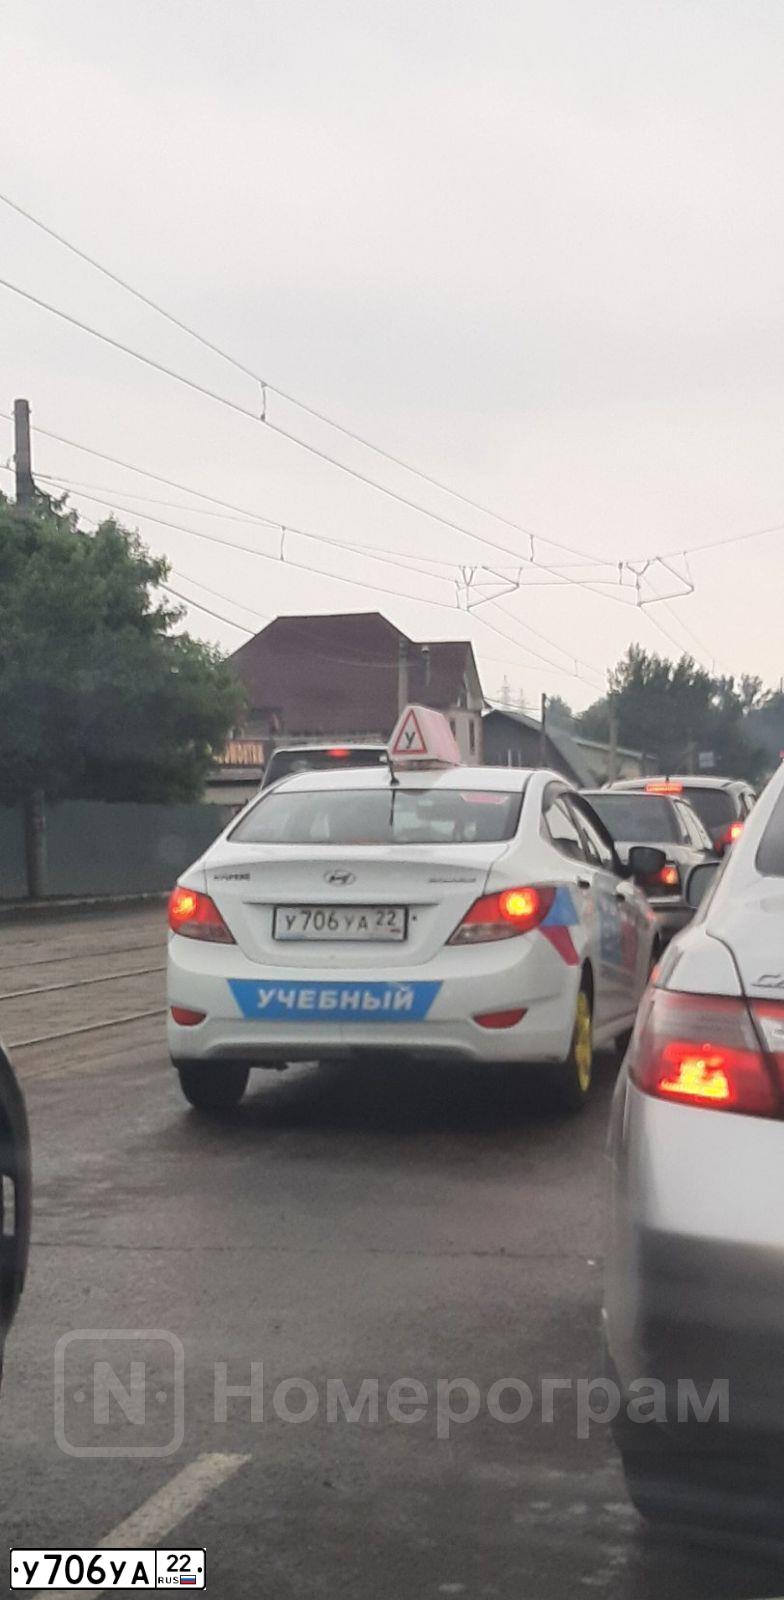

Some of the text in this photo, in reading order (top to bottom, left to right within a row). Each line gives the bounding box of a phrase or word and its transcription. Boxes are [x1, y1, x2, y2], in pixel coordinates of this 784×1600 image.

[285, 909, 397, 931] У706УА 22
[256, 985, 416, 1011] УЧЕБНЫЙ
